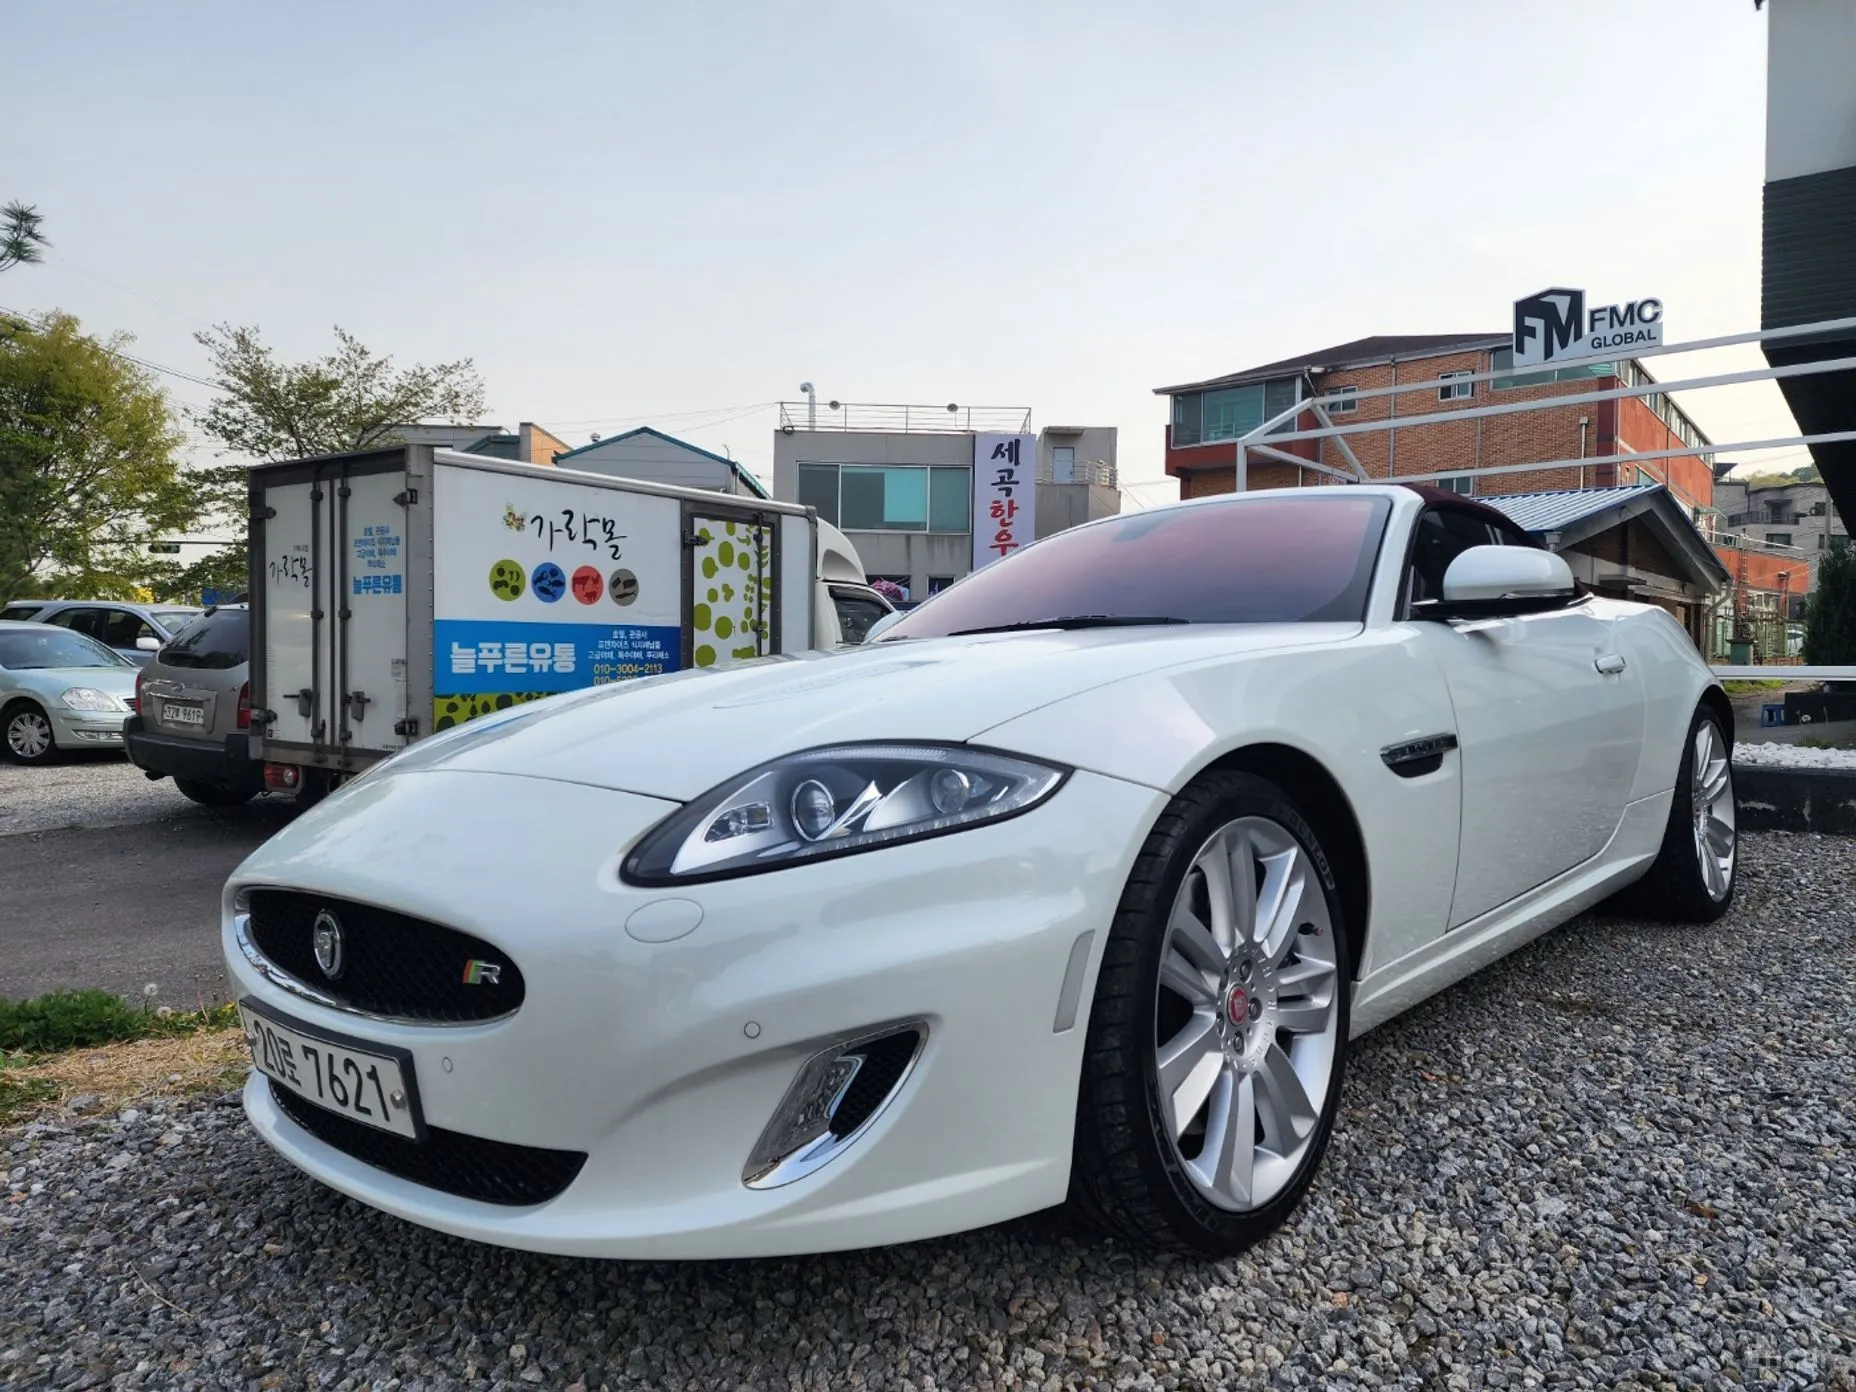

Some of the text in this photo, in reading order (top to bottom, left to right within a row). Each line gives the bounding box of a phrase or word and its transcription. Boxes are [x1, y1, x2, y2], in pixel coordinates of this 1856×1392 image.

[1590, 299, 1660, 332] FMC
[1591, 329, 1657, 349] GLOBAL
[530, 509, 628, 561] 가락몰
[352, 575, 403, 595] 늘푸른유통
[450, 641, 576, 674] 늘푸른유통
[593, 663, 664, 675] 010-3004-2113
[474, 961, 501, 985] R
[301, 1044, 391, 1122] 7621
